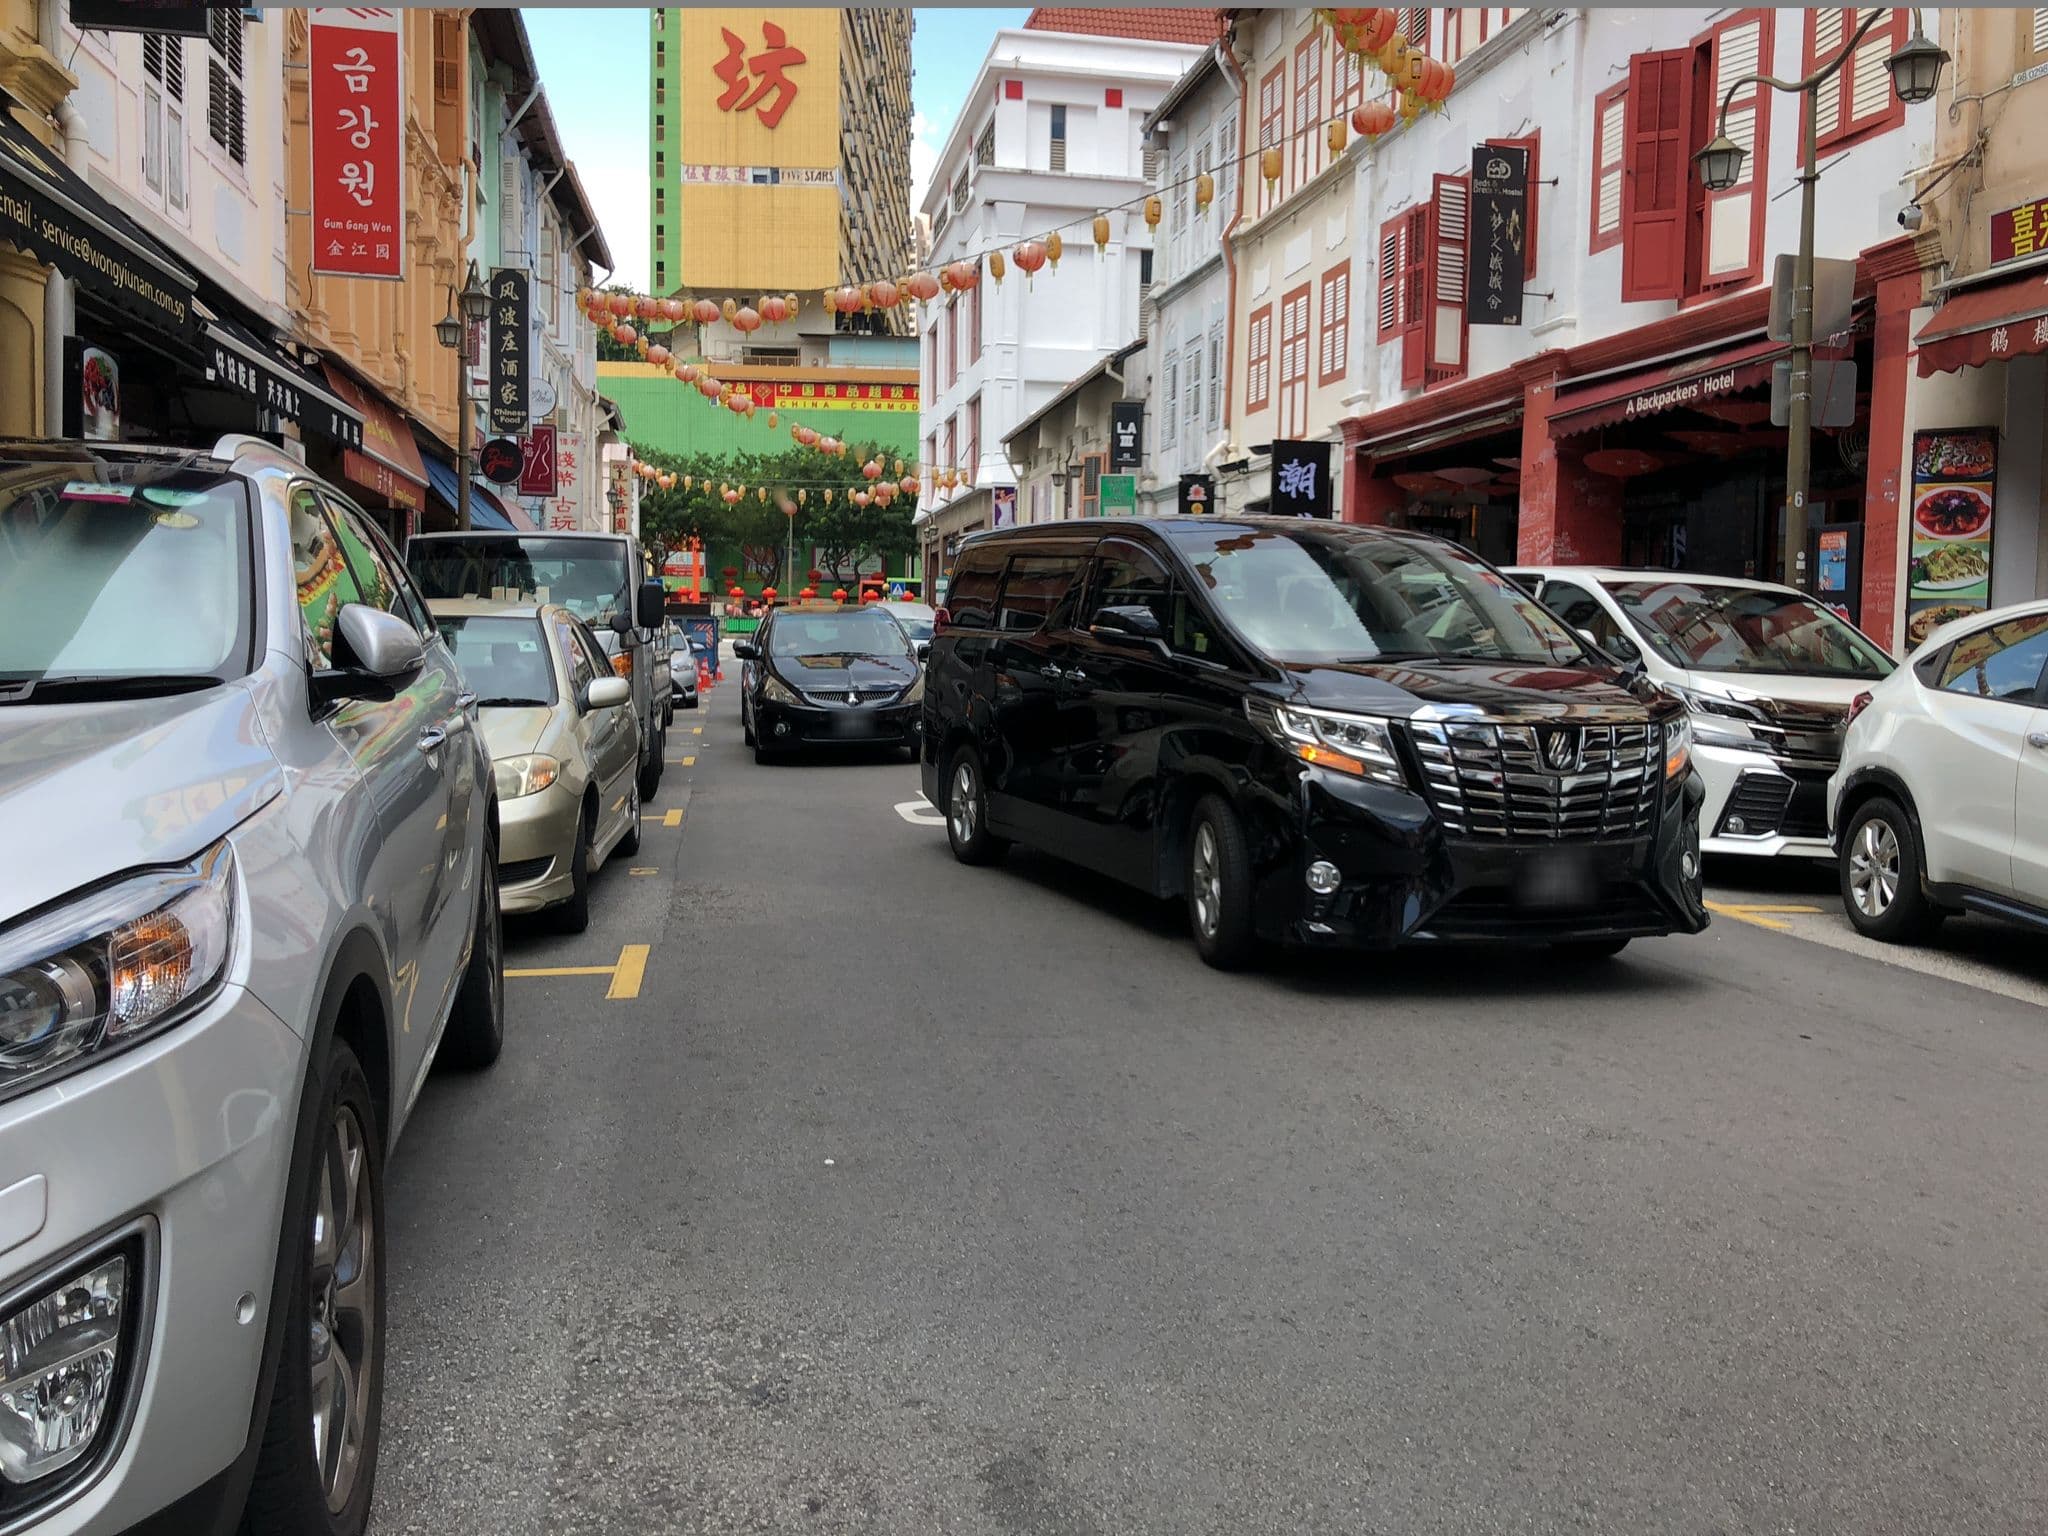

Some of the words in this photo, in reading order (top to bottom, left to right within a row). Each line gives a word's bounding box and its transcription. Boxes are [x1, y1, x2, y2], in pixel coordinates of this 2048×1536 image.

[713, 21, 806, 128] 坊
[333, 47, 379, 207] 금강원
[805, 171, 834, 182] STARS
[323, 218, 343, 229] Gum
[346, 220, 368, 233] Gang
[371, 222, 391, 233] Won
[42, 218, 185, 324] service@wongyiunam.com.sg
[1625, 400, 1635, 415] A
[1704, 369, 1735, 393] Hotel
[493, 408, 527, 417] Chinese
[779, 401, 830, 410] CHINA
[499, 416, 521, 425] Food
[1117, 422, 1137, 434] LA
[1794, 491, 1803, 508] 6
